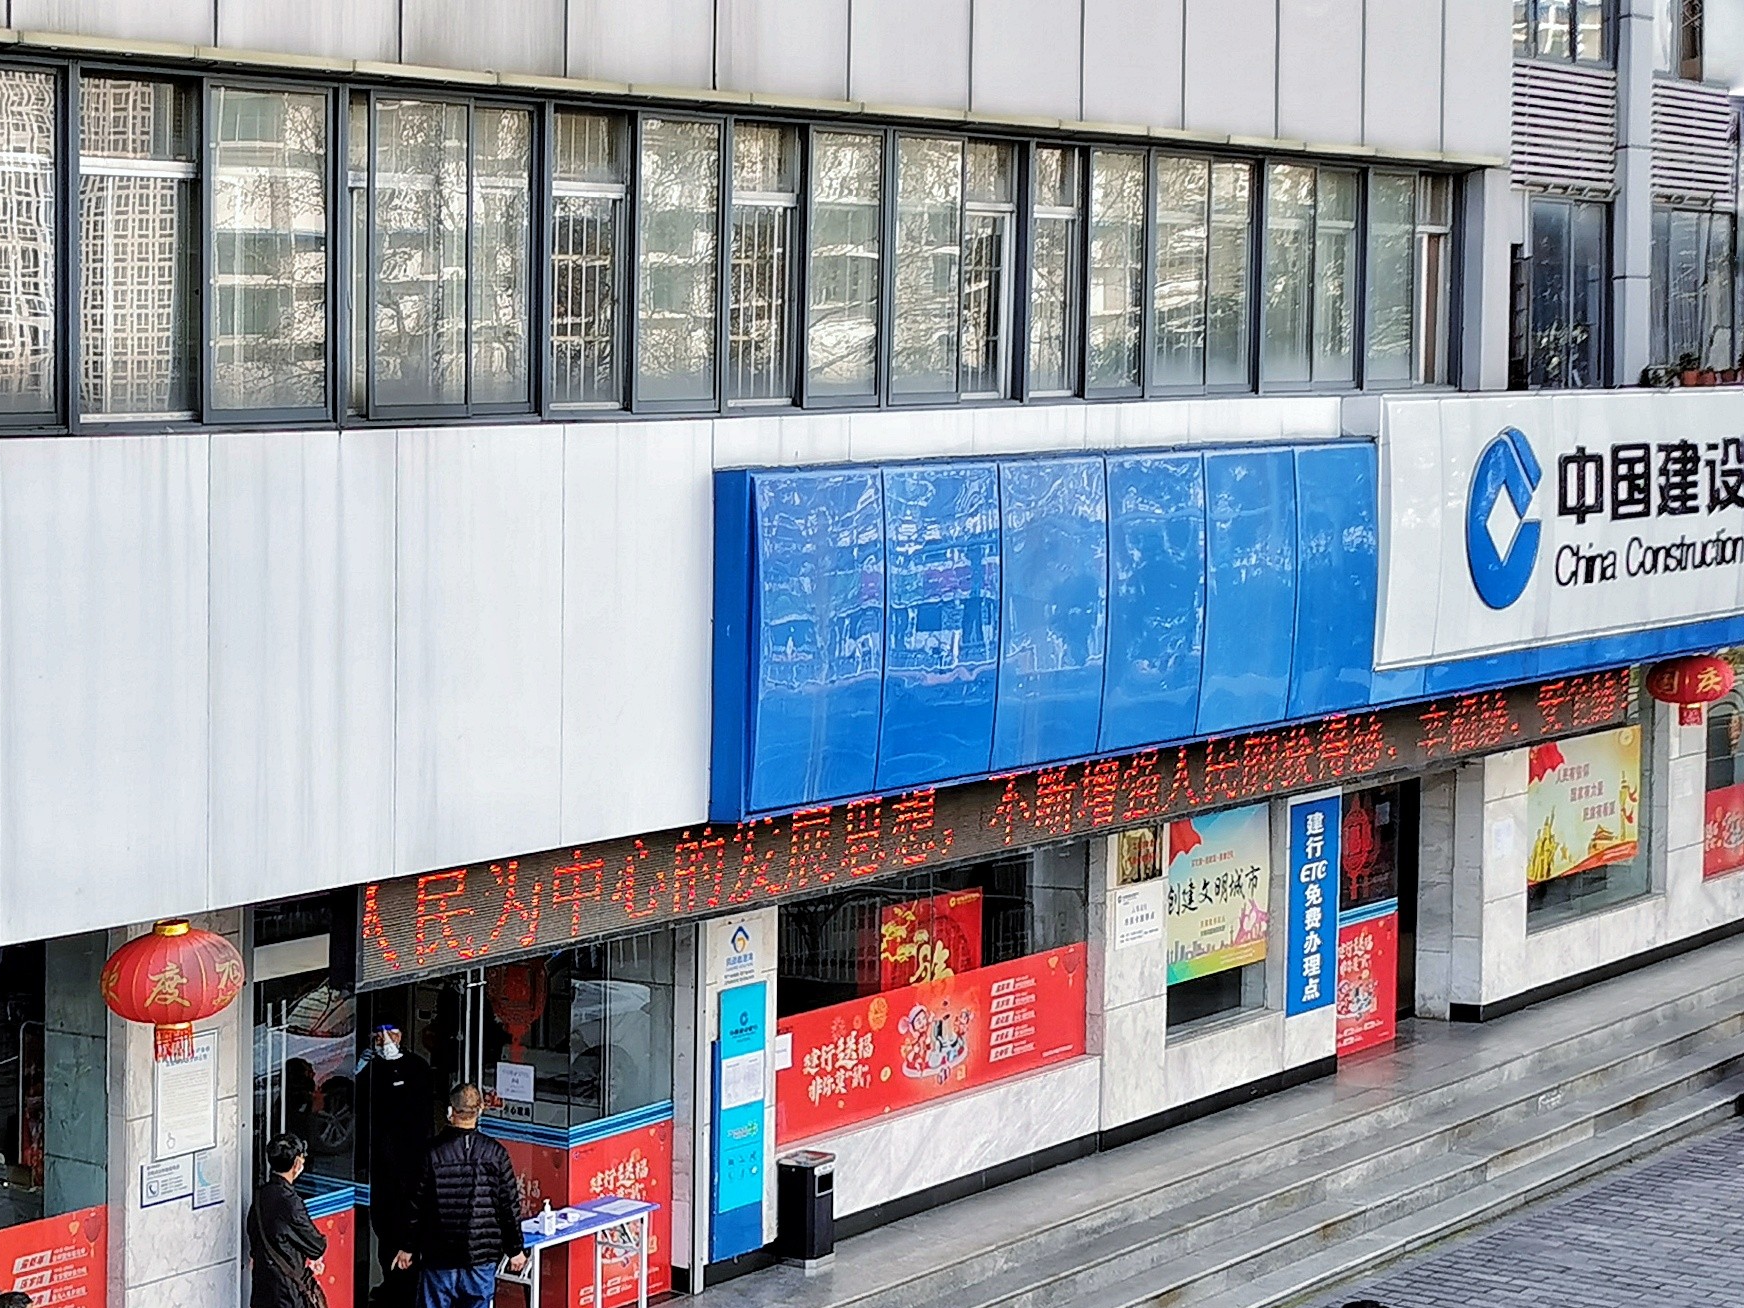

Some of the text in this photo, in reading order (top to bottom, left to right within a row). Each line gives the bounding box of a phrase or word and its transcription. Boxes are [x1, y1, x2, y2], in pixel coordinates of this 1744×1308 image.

[1557, 437, 1744, 525] 中国建设
[1556, 526, 1744, 587] China Construction
[1167, 865, 1261, 916] 创建文明城市
[1299, 811, 1329, 1002] 建行ETC免费办理点
